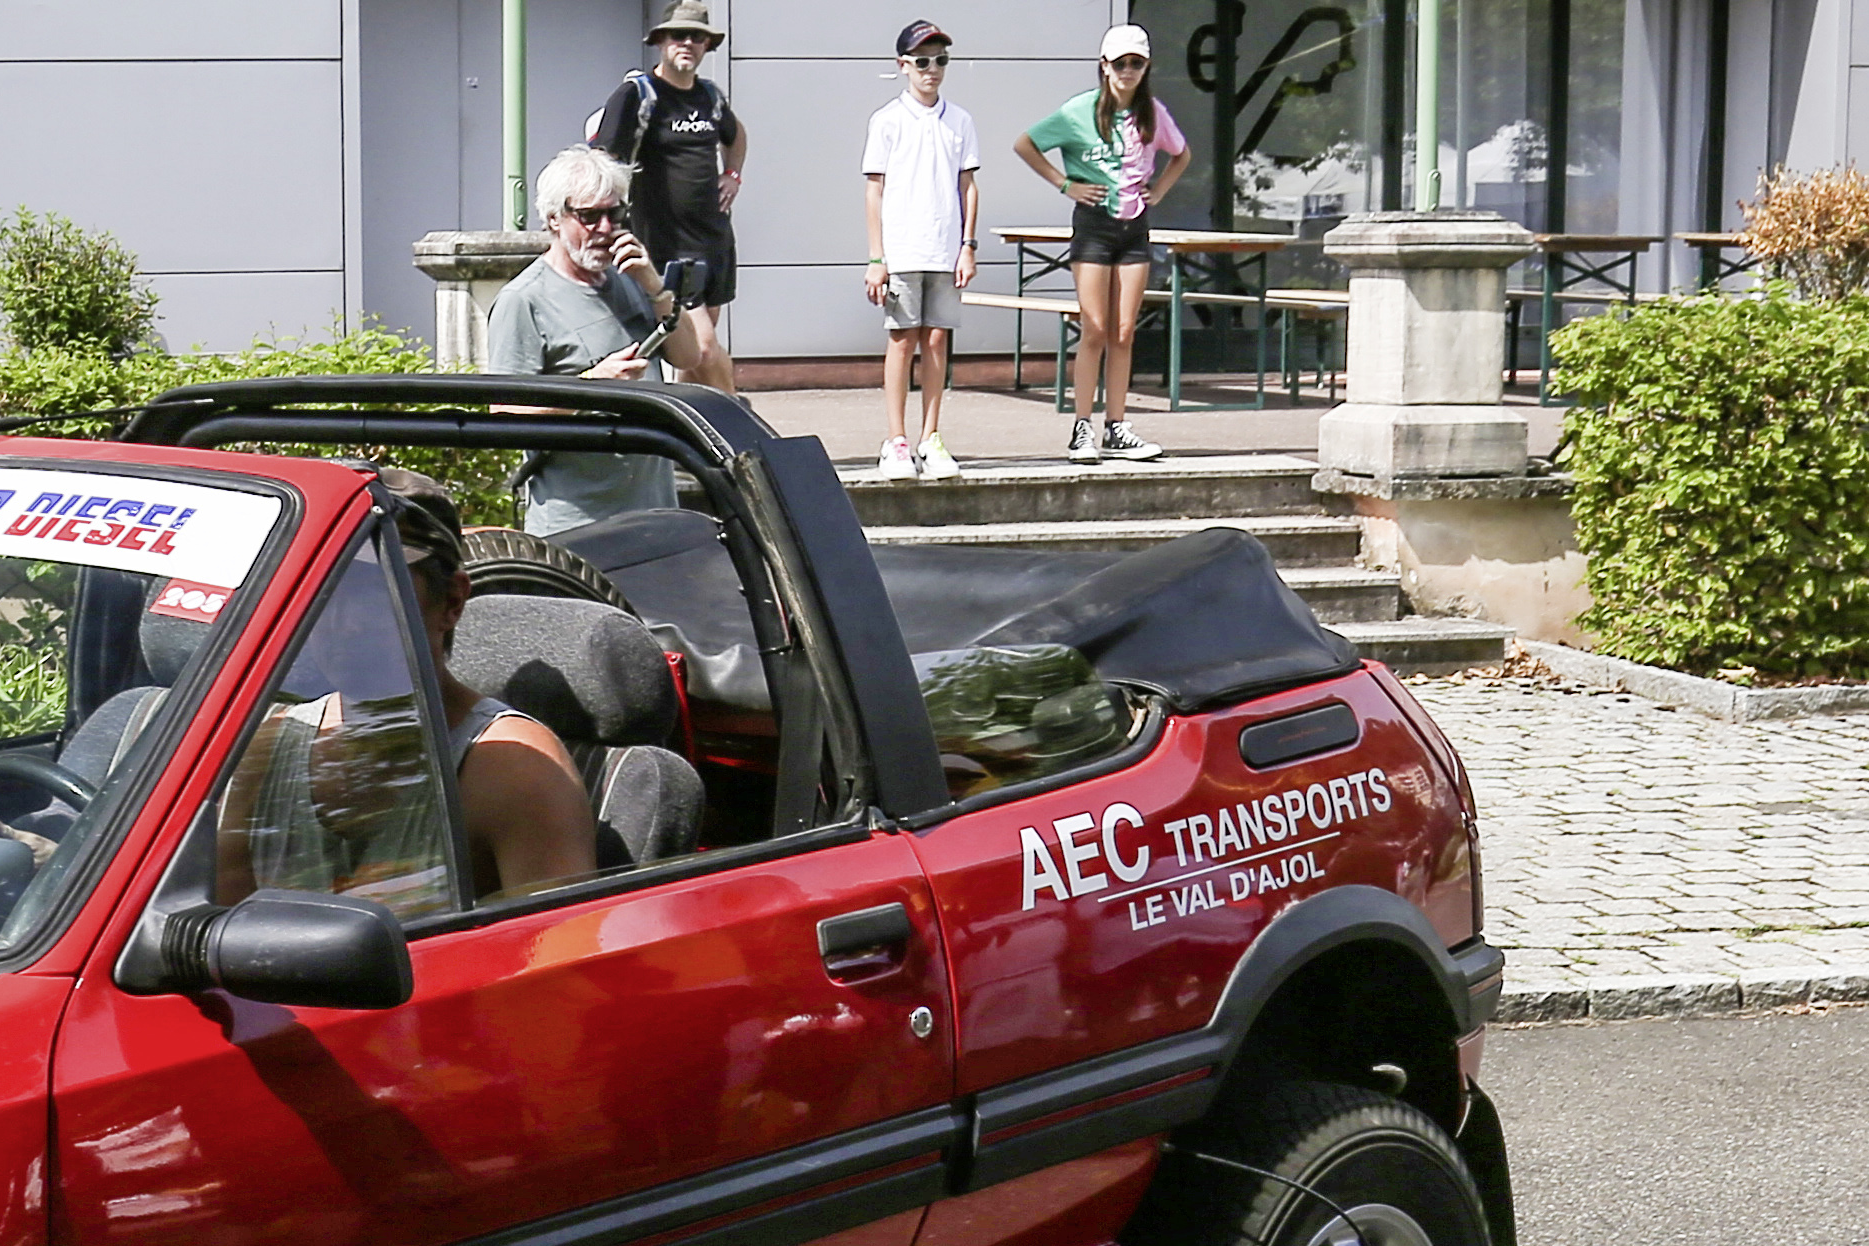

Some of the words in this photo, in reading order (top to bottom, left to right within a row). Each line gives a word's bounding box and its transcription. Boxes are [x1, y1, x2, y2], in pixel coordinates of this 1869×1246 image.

[4, 492, 197, 555] DIESEL
[157, 586, 227, 614] 205
[1019, 802, 1150, 911] AEC
[1164, 767, 1392, 867] TRANSPORTS
[1128, 894, 1166, 931] LE
[1171, 883, 1225, 917] VAL
[1231, 850, 1325, 902] D'AJOL
